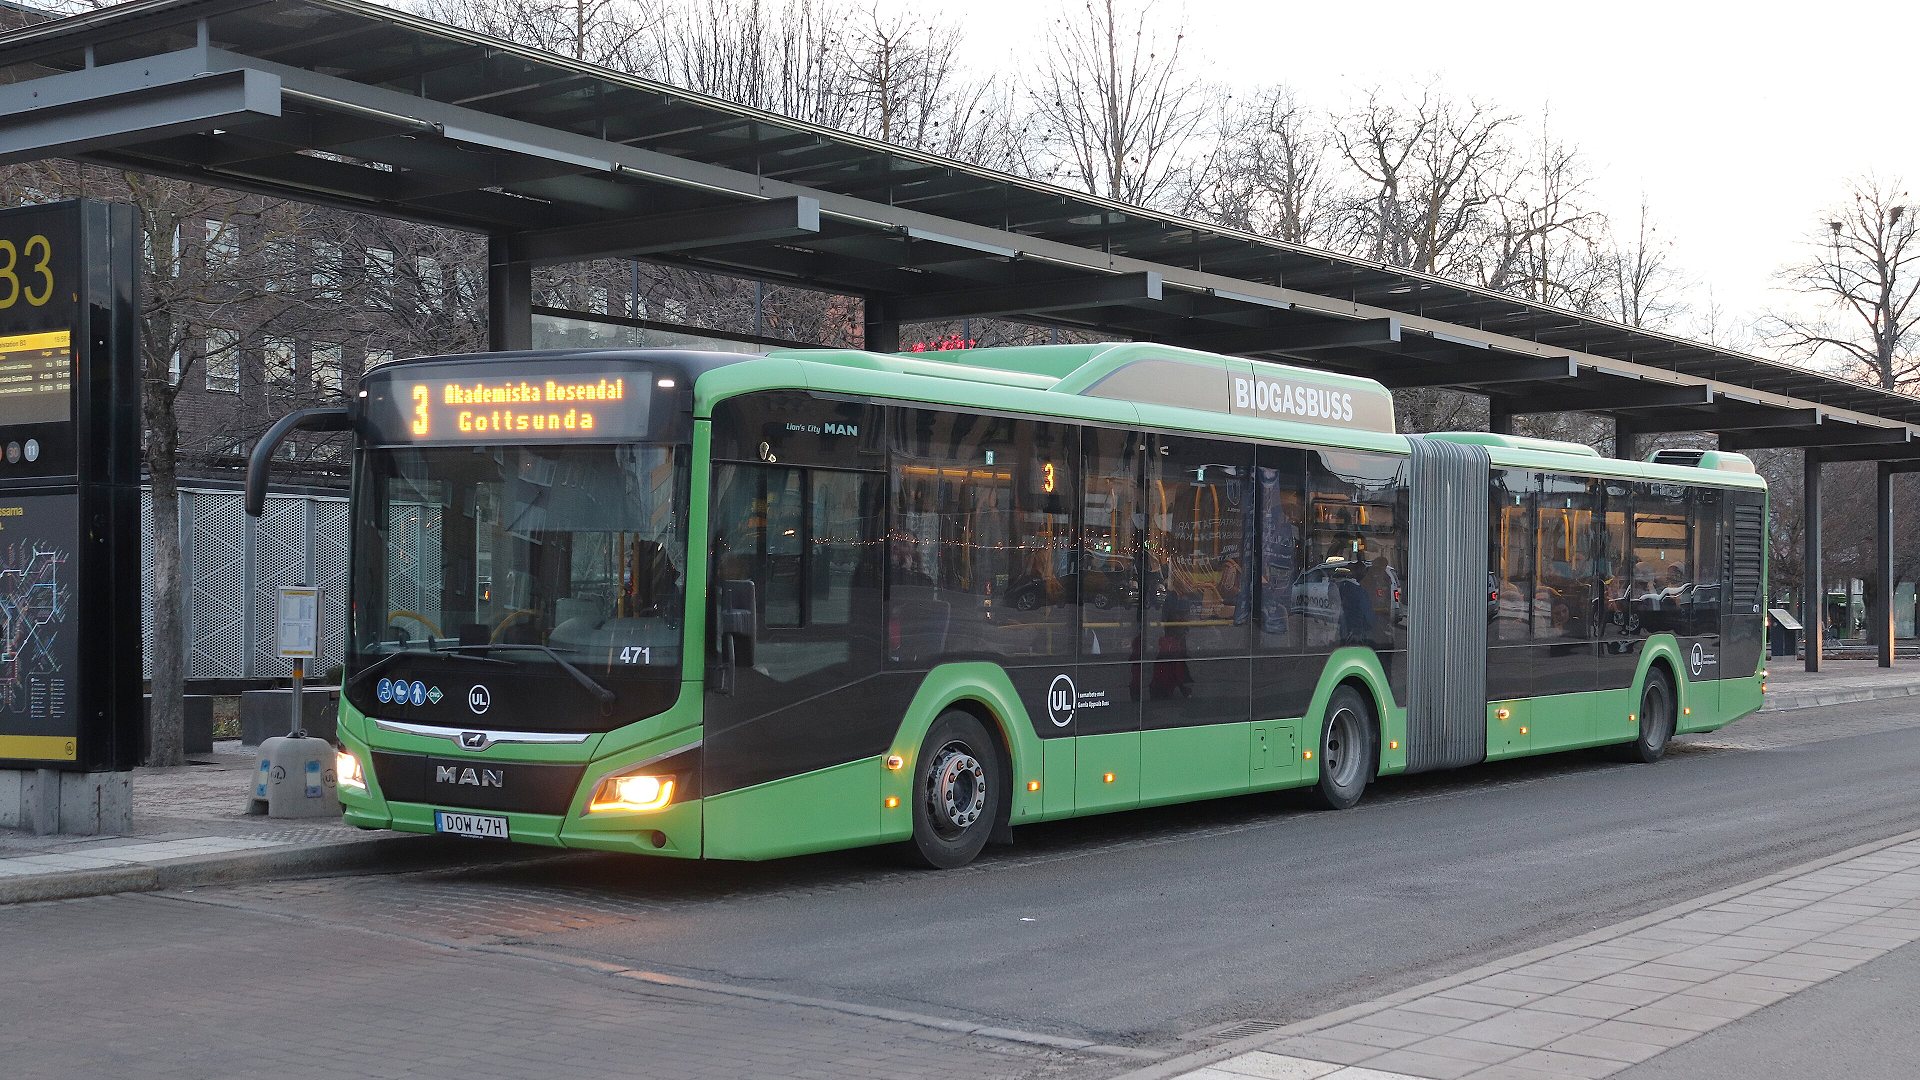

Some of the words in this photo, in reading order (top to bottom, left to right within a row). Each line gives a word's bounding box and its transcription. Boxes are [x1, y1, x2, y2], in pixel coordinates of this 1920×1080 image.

[0, 234, 54, 310] B3
[445, 383, 541, 404] Akademiska
[545, 379, 623, 401] Rosendal
[1235, 377, 1353, 422] BIOGASBUSS
[413, 386, 428, 434] 3
[459, 409, 593, 432] Gottsunda
[786, 422, 805, 432] Lion's
[808, 425, 820, 434] City
[824, 423, 857, 436] MAN
[27, 445, 36, 456] 11
[1042, 463, 1054, 493] 3
[620, 646, 650, 665] 471
[472, 694, 486, 705] UL
[1053, 691, 1071, 711] UL
[436, 766, 503, 787] MAN
[446, 815, 472, 832] DOW
[476, 818, 502, 835] 47H
